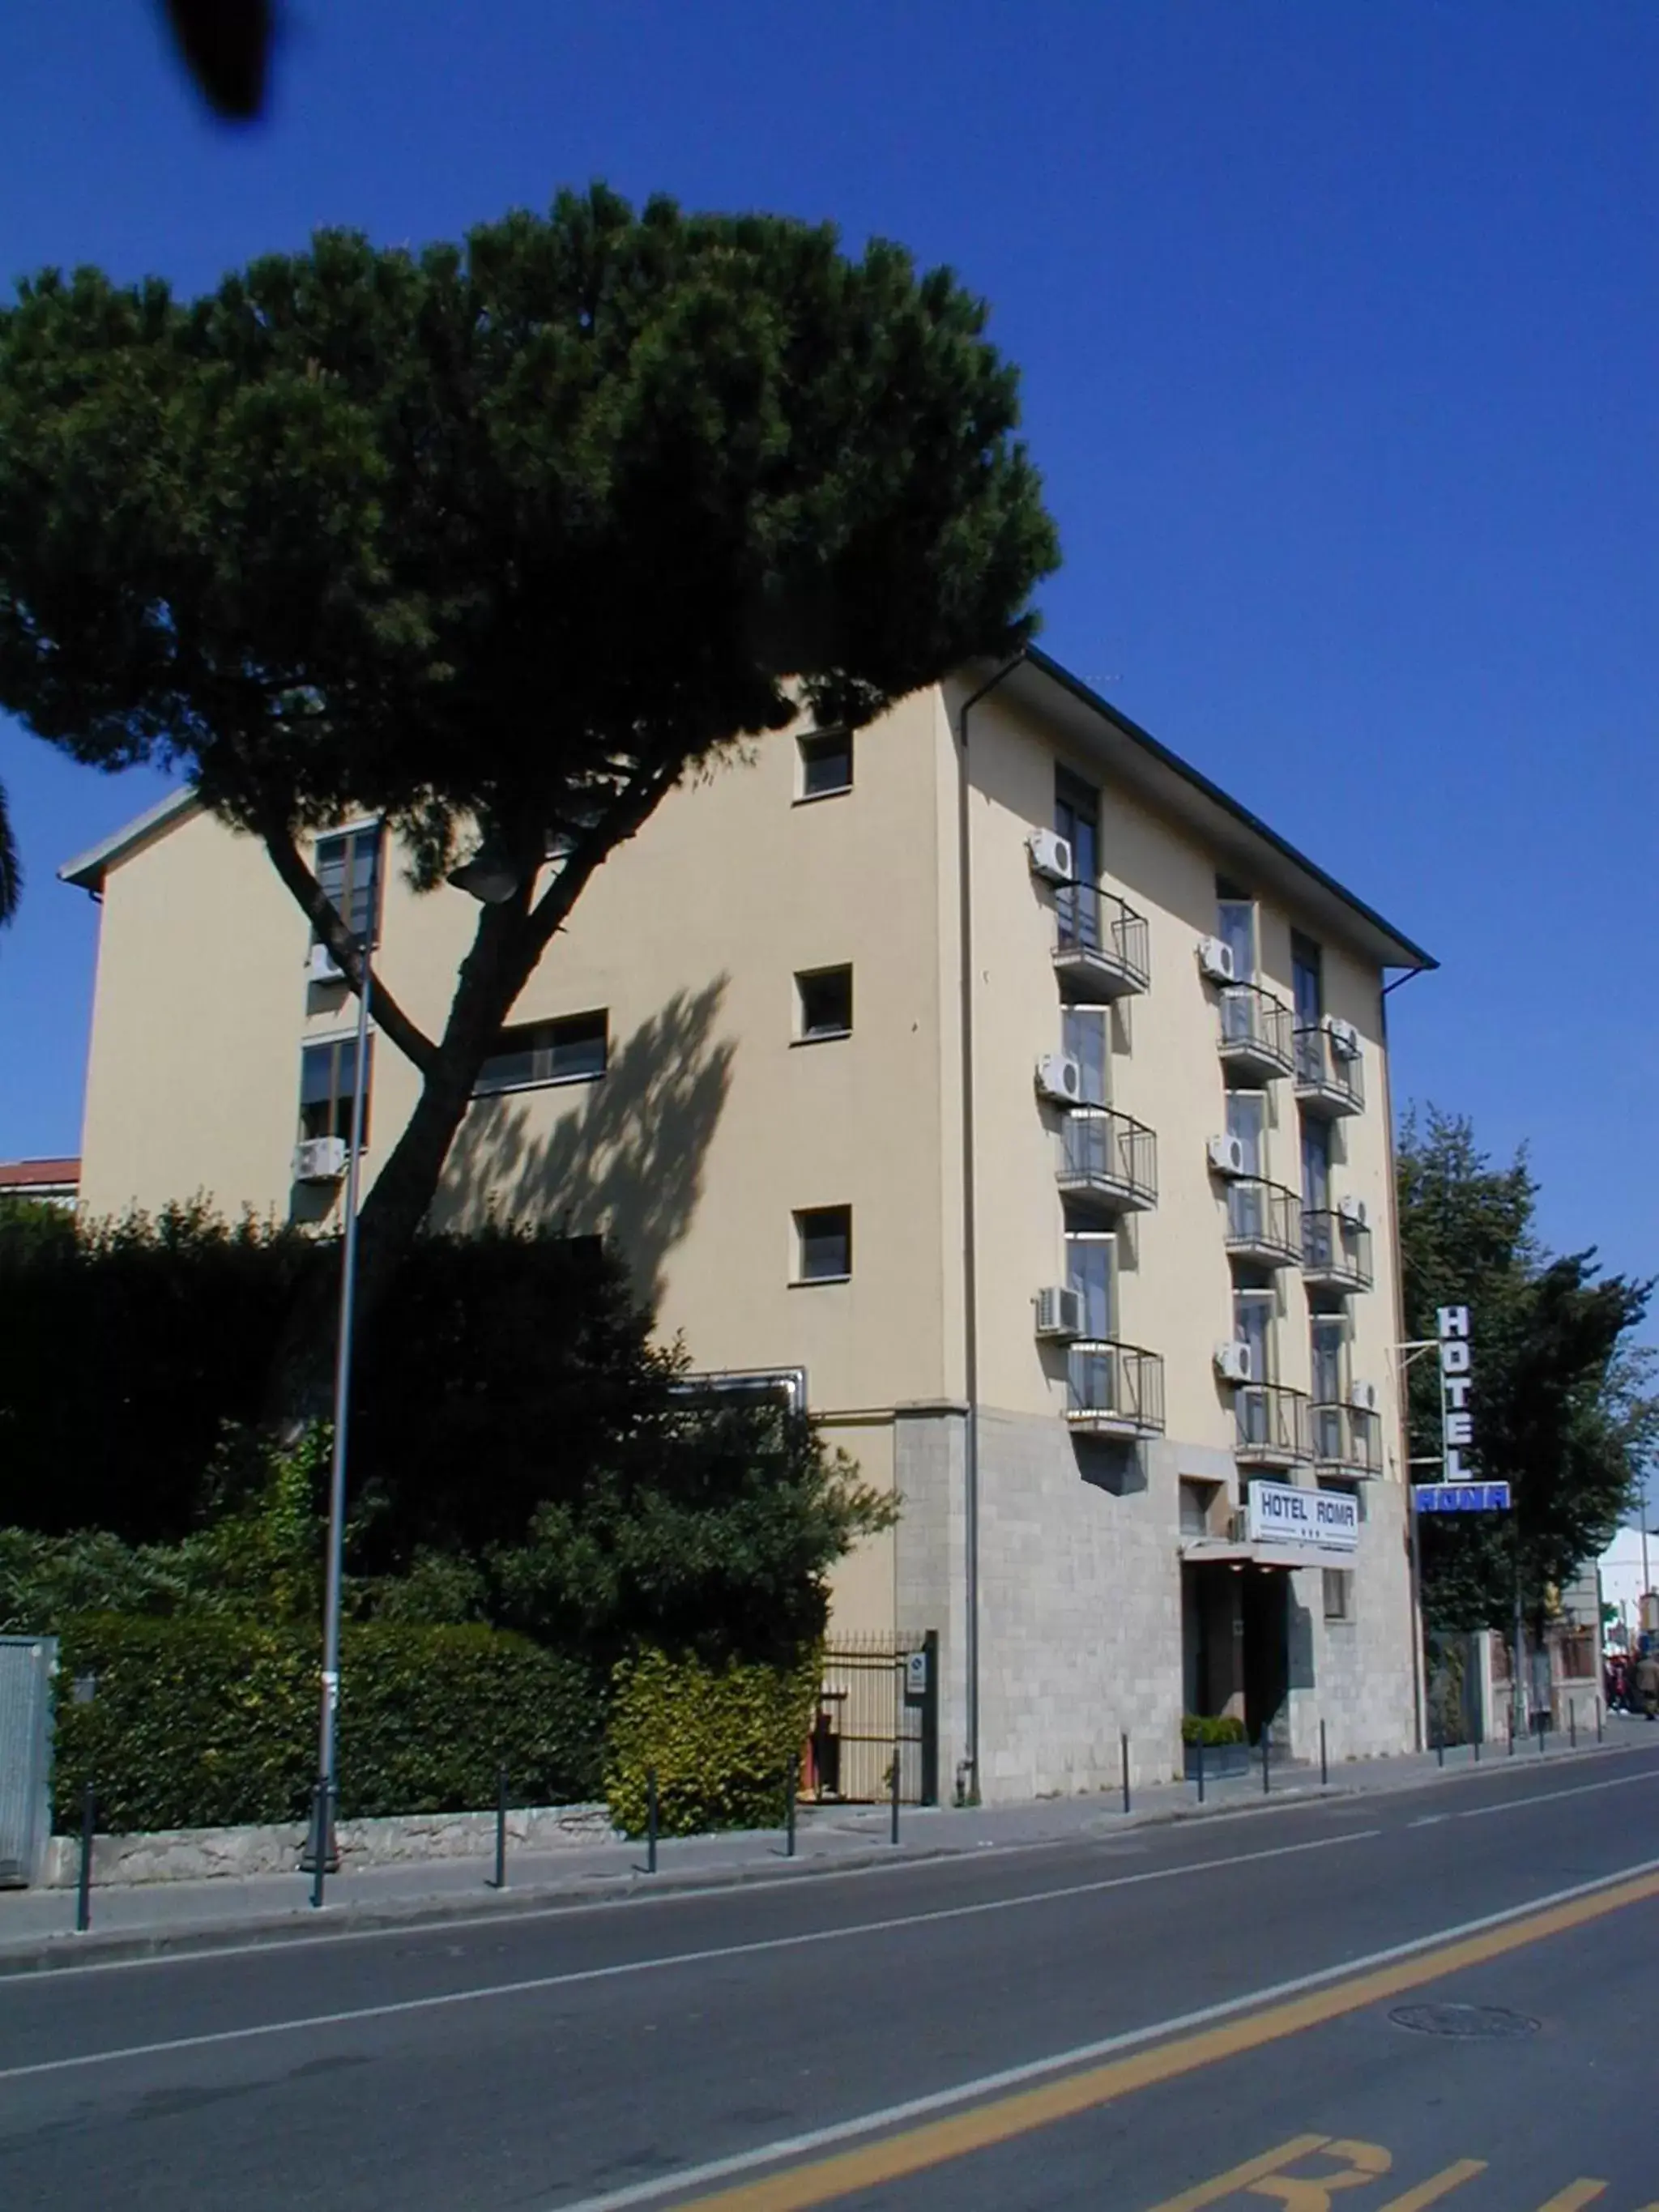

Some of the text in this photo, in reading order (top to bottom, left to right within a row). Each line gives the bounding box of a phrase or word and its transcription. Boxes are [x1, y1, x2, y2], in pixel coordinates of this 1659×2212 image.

[1437, 1306, 1473, 1480] HOTEL
[1262, 1492, 1354, 1527] HOTEL ROMA
